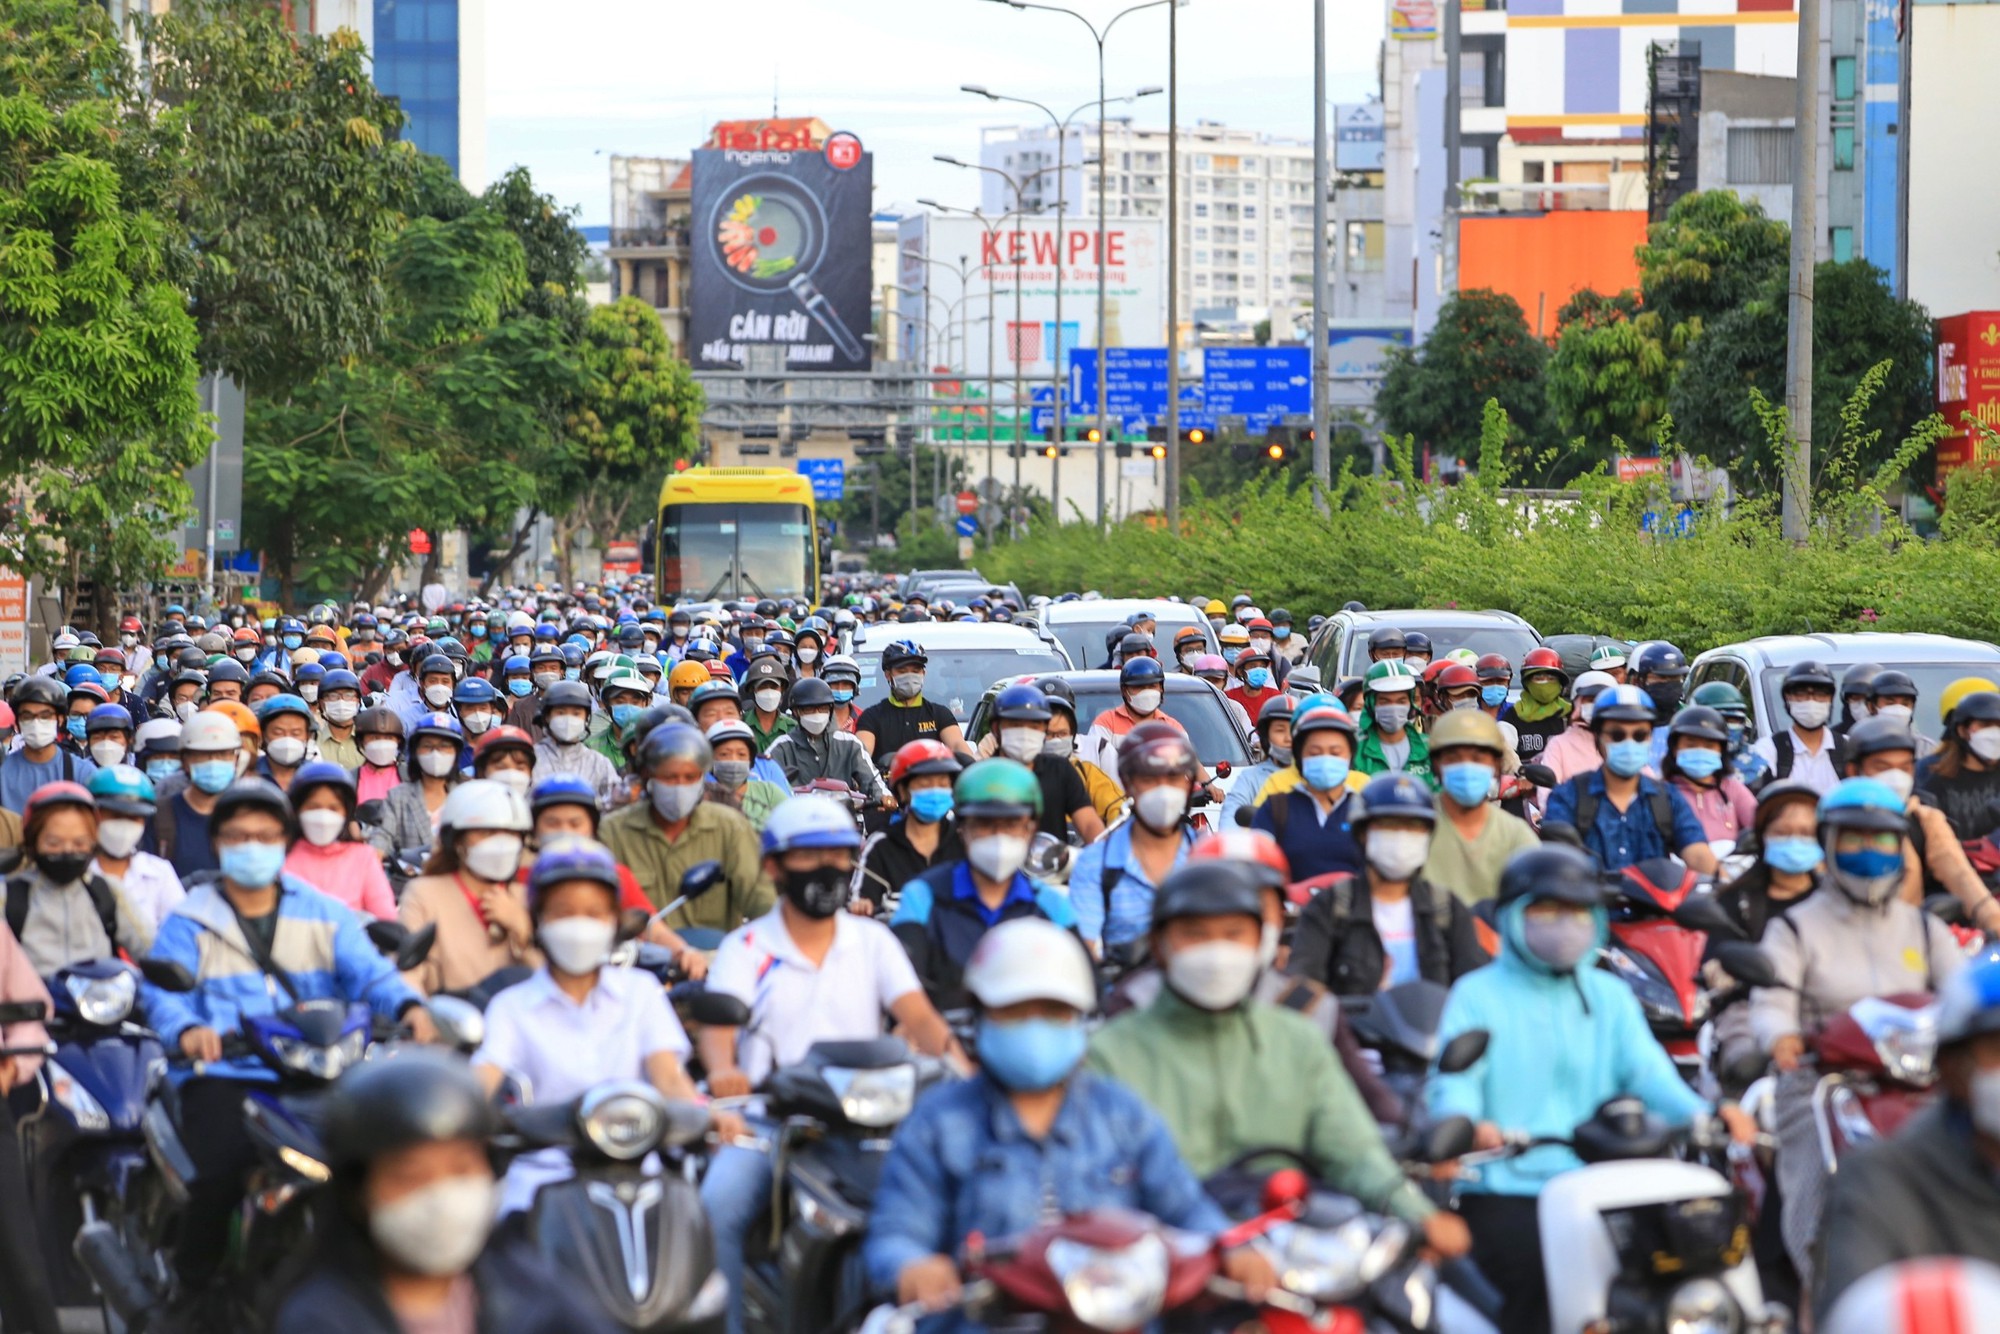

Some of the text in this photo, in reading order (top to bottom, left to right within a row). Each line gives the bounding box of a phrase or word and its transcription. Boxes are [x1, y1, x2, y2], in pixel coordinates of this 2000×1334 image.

[716, 126, 818, 151] Tefal
[981, 230, 1126, 266] KEWPIE
[981, 269, 1052, 284] Mayonaise
[1073, 269, 1127, 284] Dresing
[730, 310, 809, 341] CÁN RỜI
[788, 344, 835, 362] NHANH
